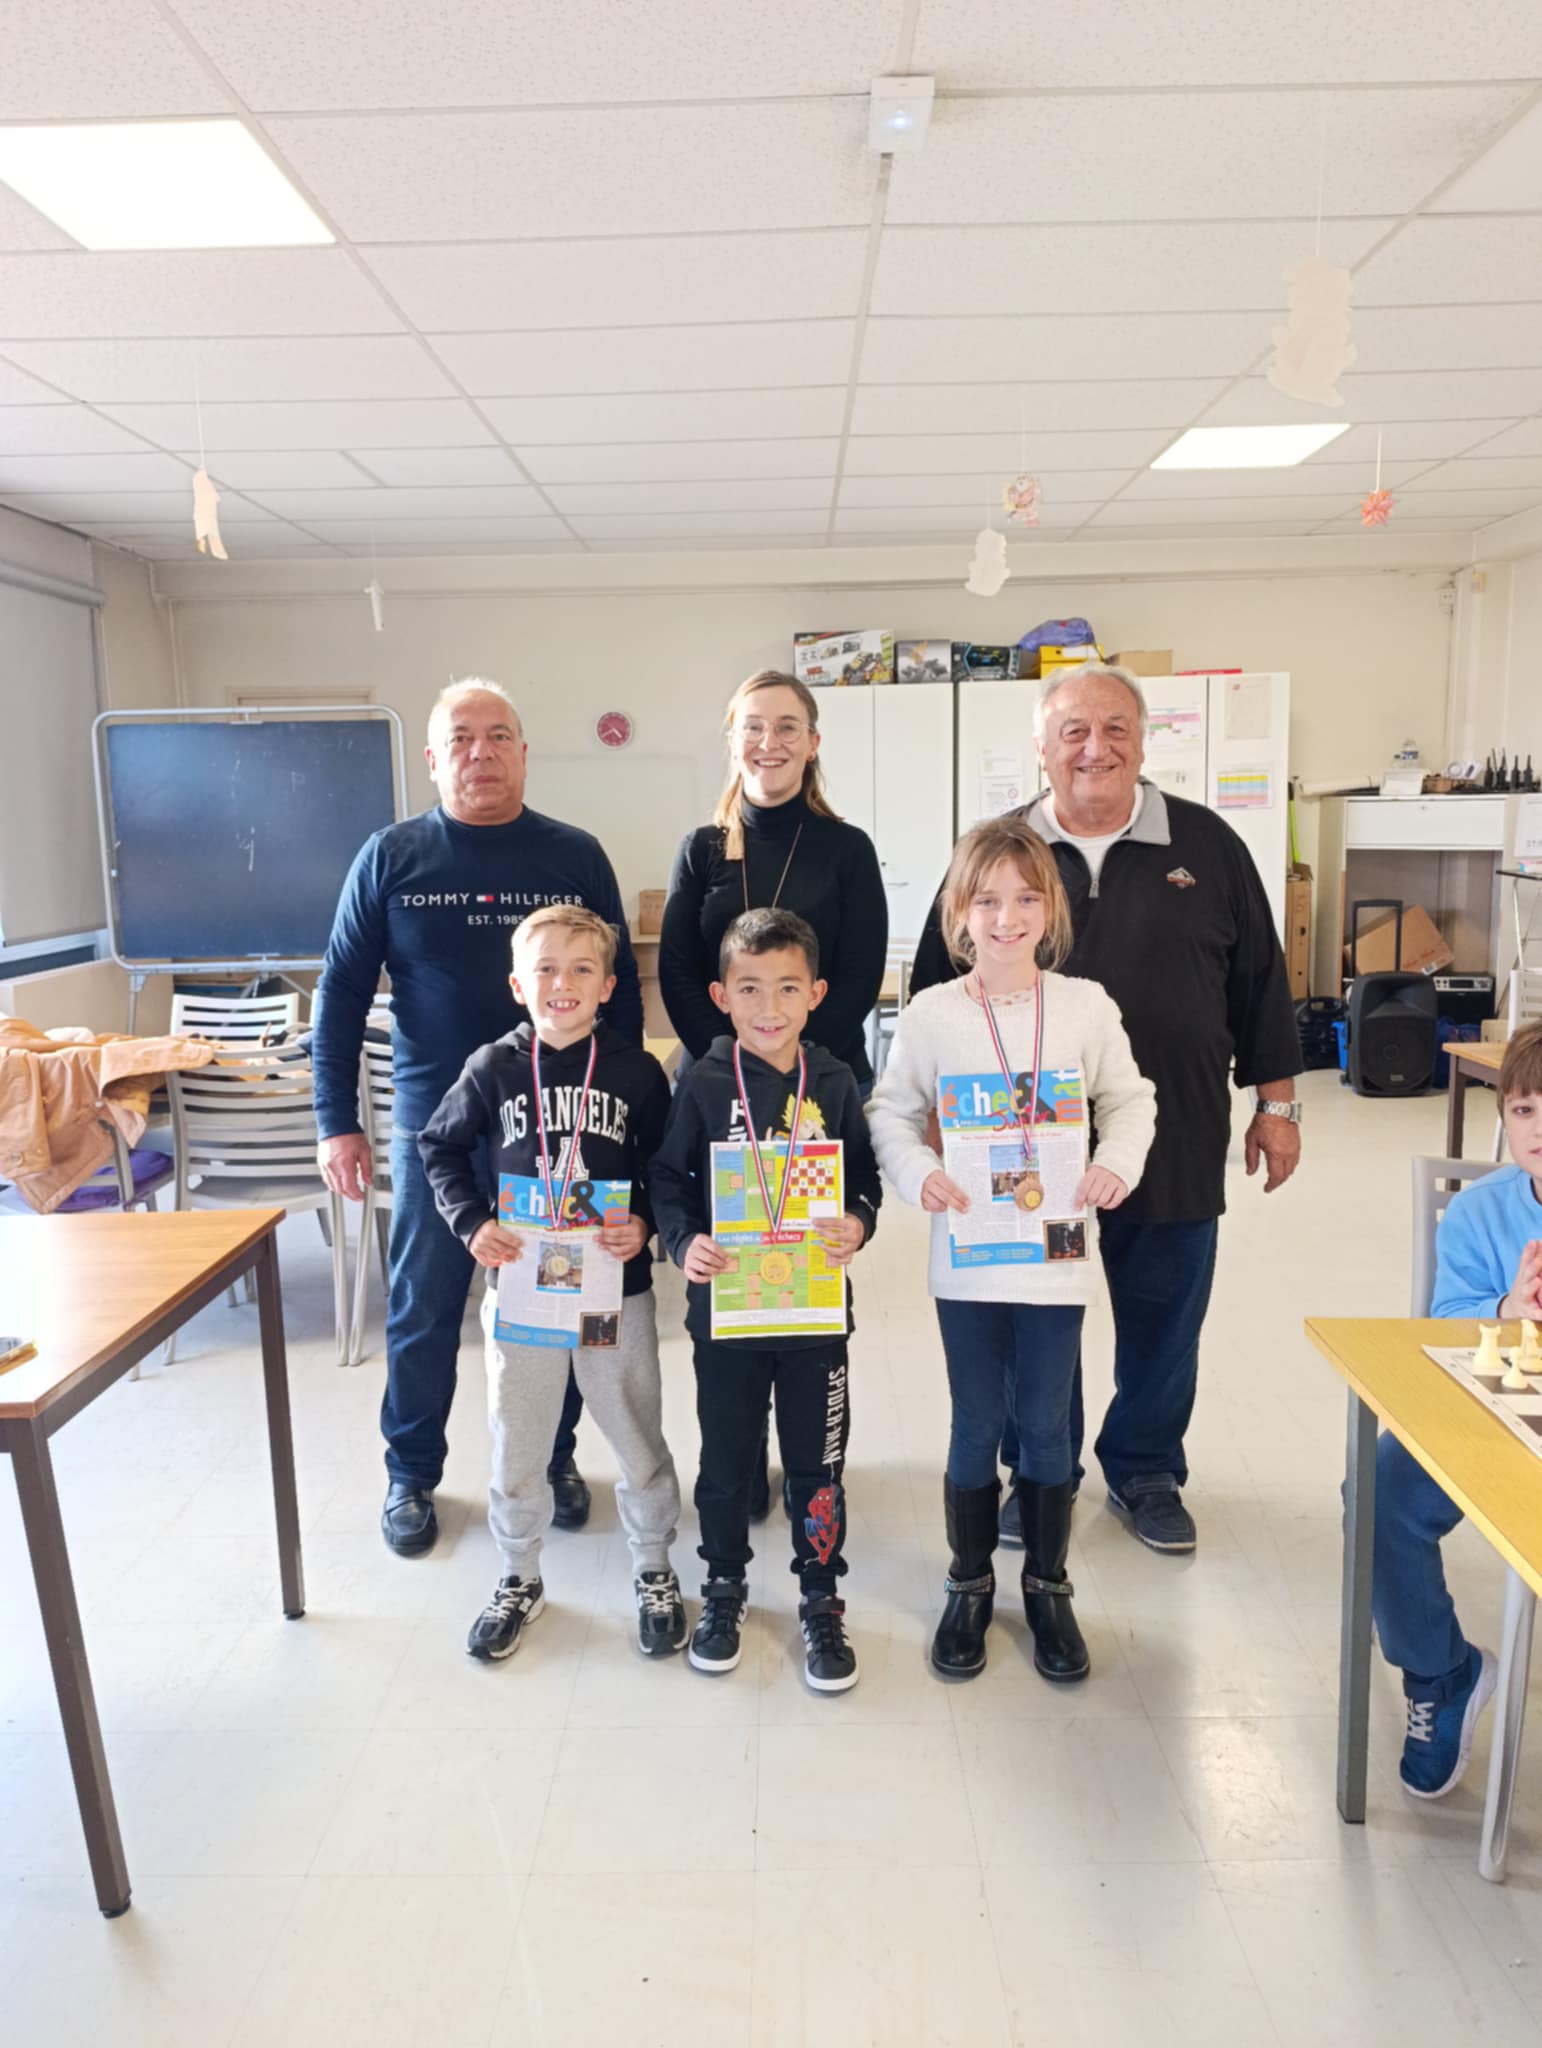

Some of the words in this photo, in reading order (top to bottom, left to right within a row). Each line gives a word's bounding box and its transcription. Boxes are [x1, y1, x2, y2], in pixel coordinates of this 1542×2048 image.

[401, 893, 470, 907] TOMMY
[500, 892, 583, 907] HILFIGER
[467, 914, 494, 925] EST.
